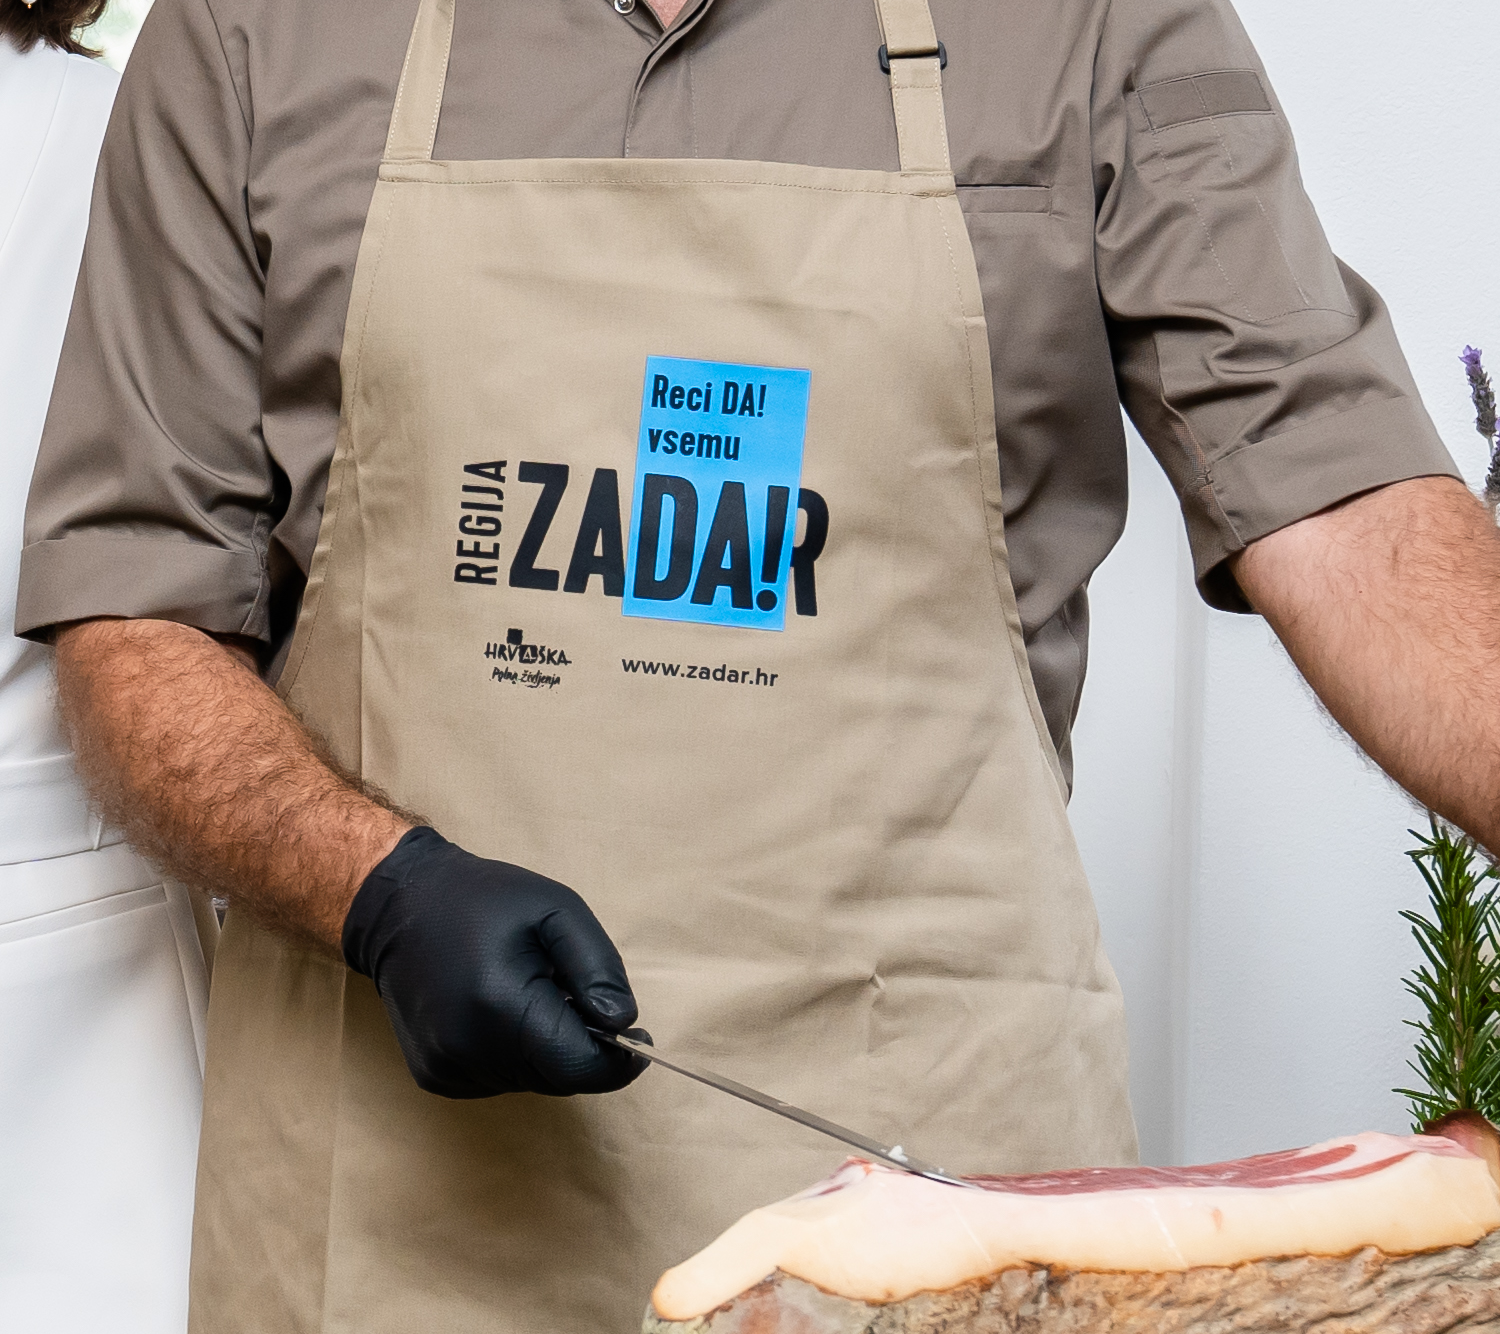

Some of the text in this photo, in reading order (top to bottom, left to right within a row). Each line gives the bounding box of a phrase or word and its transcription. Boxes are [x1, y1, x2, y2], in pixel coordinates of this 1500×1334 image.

[651, 374, 767, 417] Reci DA!
[648, 427, 740, 461] vsemu
[454, 460, 507, 585] REGIJA
[621, 658, 778, 687] www.zadar.hr
